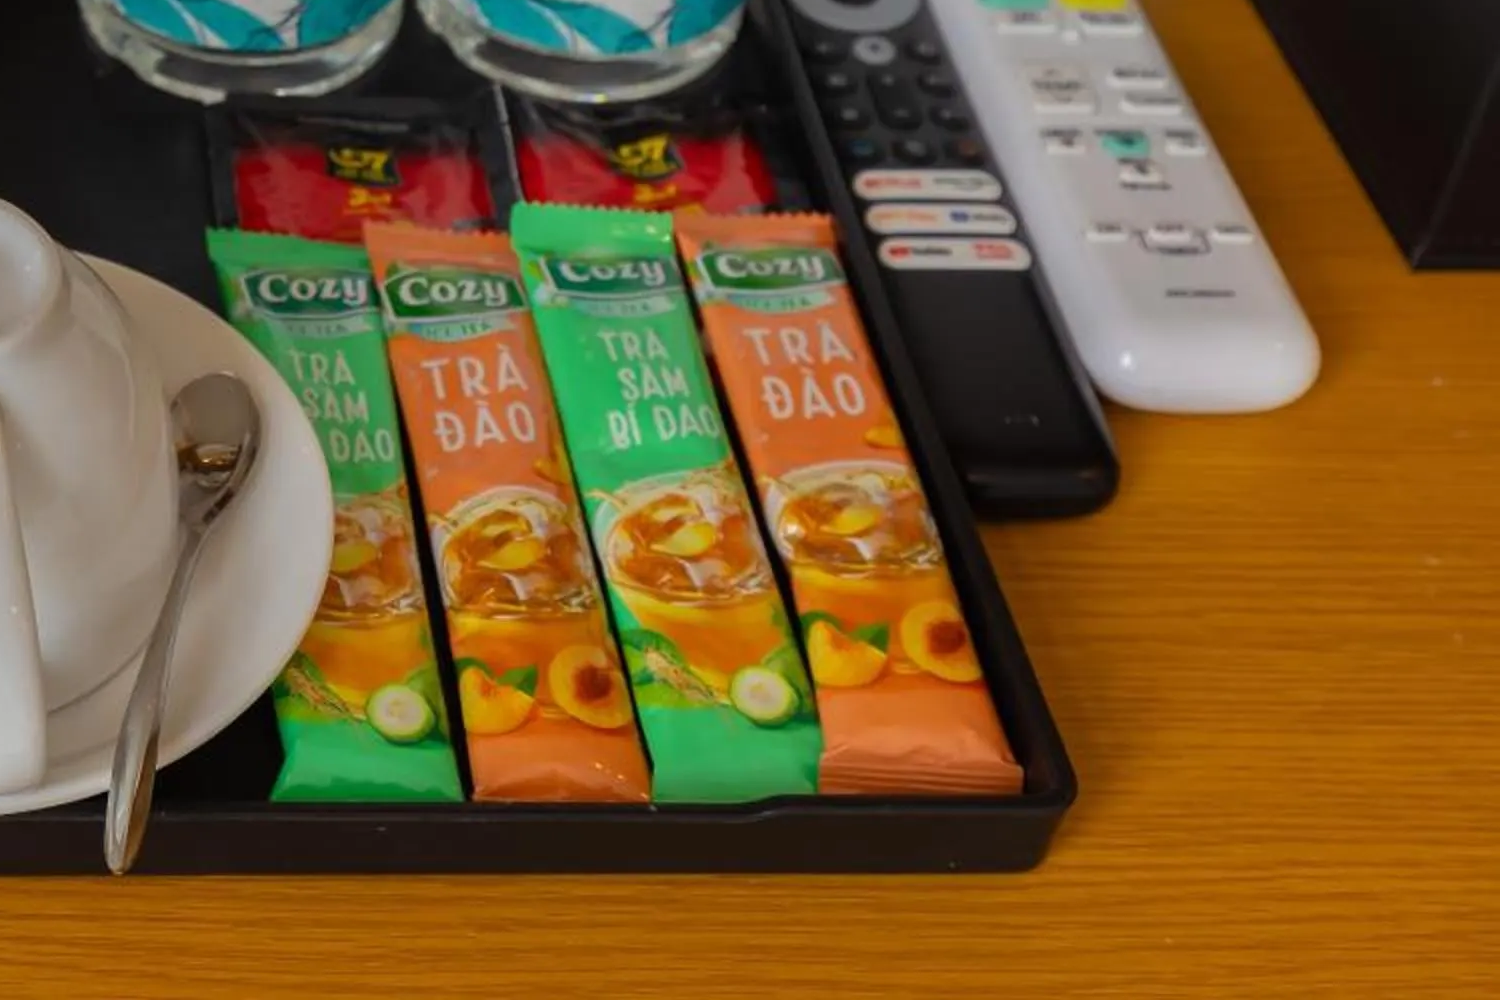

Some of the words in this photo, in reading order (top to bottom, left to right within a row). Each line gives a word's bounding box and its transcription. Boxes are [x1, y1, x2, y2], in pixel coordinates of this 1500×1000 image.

[558, 258, 667, 286] Cozy
[716, 253, 825, 281] Cozy
[258, 272, 368, 306] Cozy
[400, 275, 508, 308] Cozy
[742, 319, 854, 366] TRÀ
[420, 342, 529, 400] TRÀ
[762, 366, 867, 420] ĐÀO
[433, 400, 536, 453] ĐÀO
